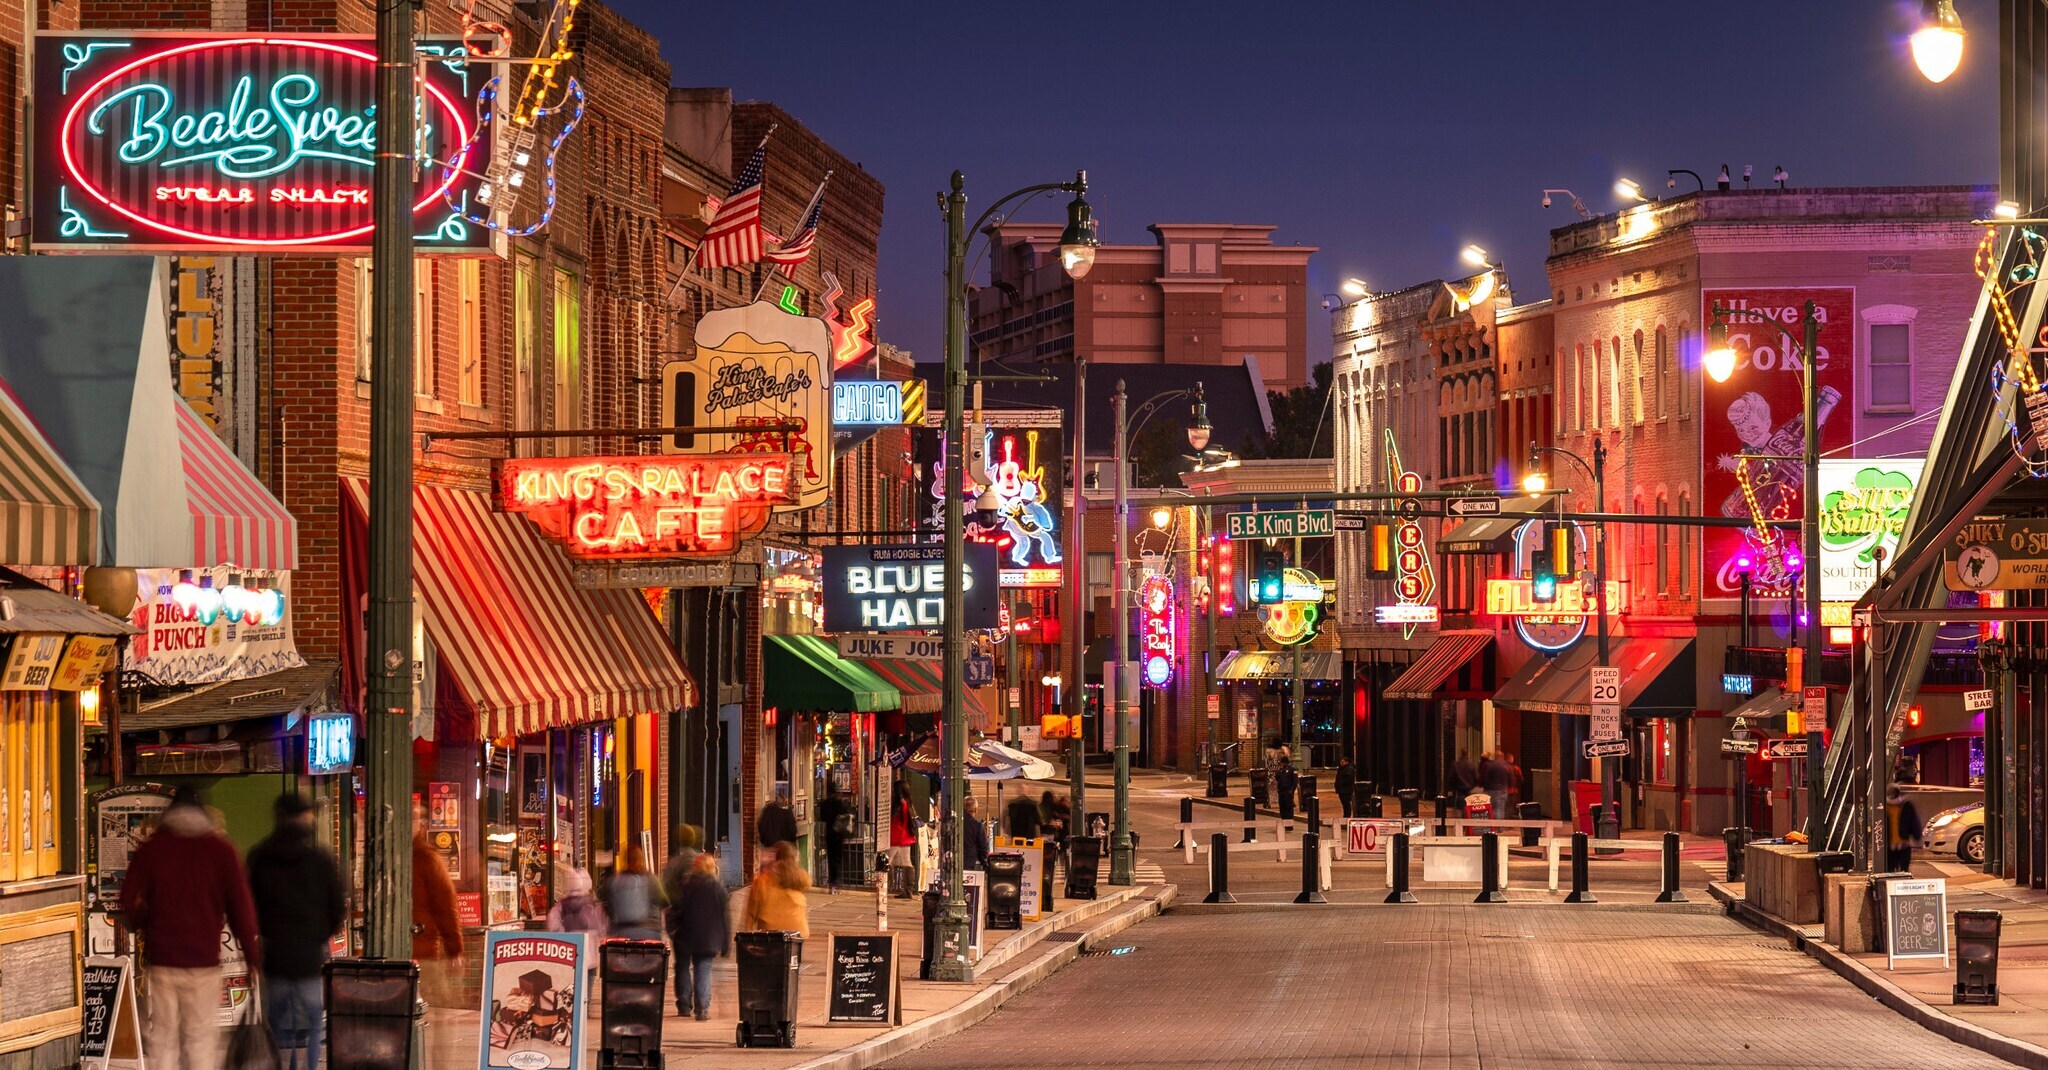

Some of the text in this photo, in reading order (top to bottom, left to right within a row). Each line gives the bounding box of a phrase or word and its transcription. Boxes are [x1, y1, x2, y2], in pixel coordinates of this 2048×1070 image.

[88, 74, 276, 164] Beale
[155, 186, 369, 204] SUGAR SHACK
[1727, 298, 1828, 325] Have a
[177, 256, 216, 431] LUES
[1727, 331, 1831, 371] Coke
[713, 363, 766, 390] Kings
[705, 369, 812, 413] Palace Cafe's
[833, 384, 898, 421] CARGO
[640, 466, 786, 499] PALACE
[1462, 502, 1477, 510] ONE
[576, 505, 727, 546] CAFE
[1231, 513, 1332, 536] B.B. King Blvd.
[1955, 523, 2006, 549] SILKY
[873, 549, 891, 560] RUM
[153, 626, 207, 651] PUNCH
[847, 639, 944, 657] JUKE JOI
[23, 666, 50, 686] BEER
[1593, 685, 1617, 699] 20
[1967, 692, 1993, 700] STREE
[1974, 700, 1992, 708] BAR
[1351, 824, 1377, 851] NO
[1900, 900, 1921, 915] BIG
[1899, 916, 1919, 934] ASS
[496, 942, 574, 961] FRESH FUDGE
